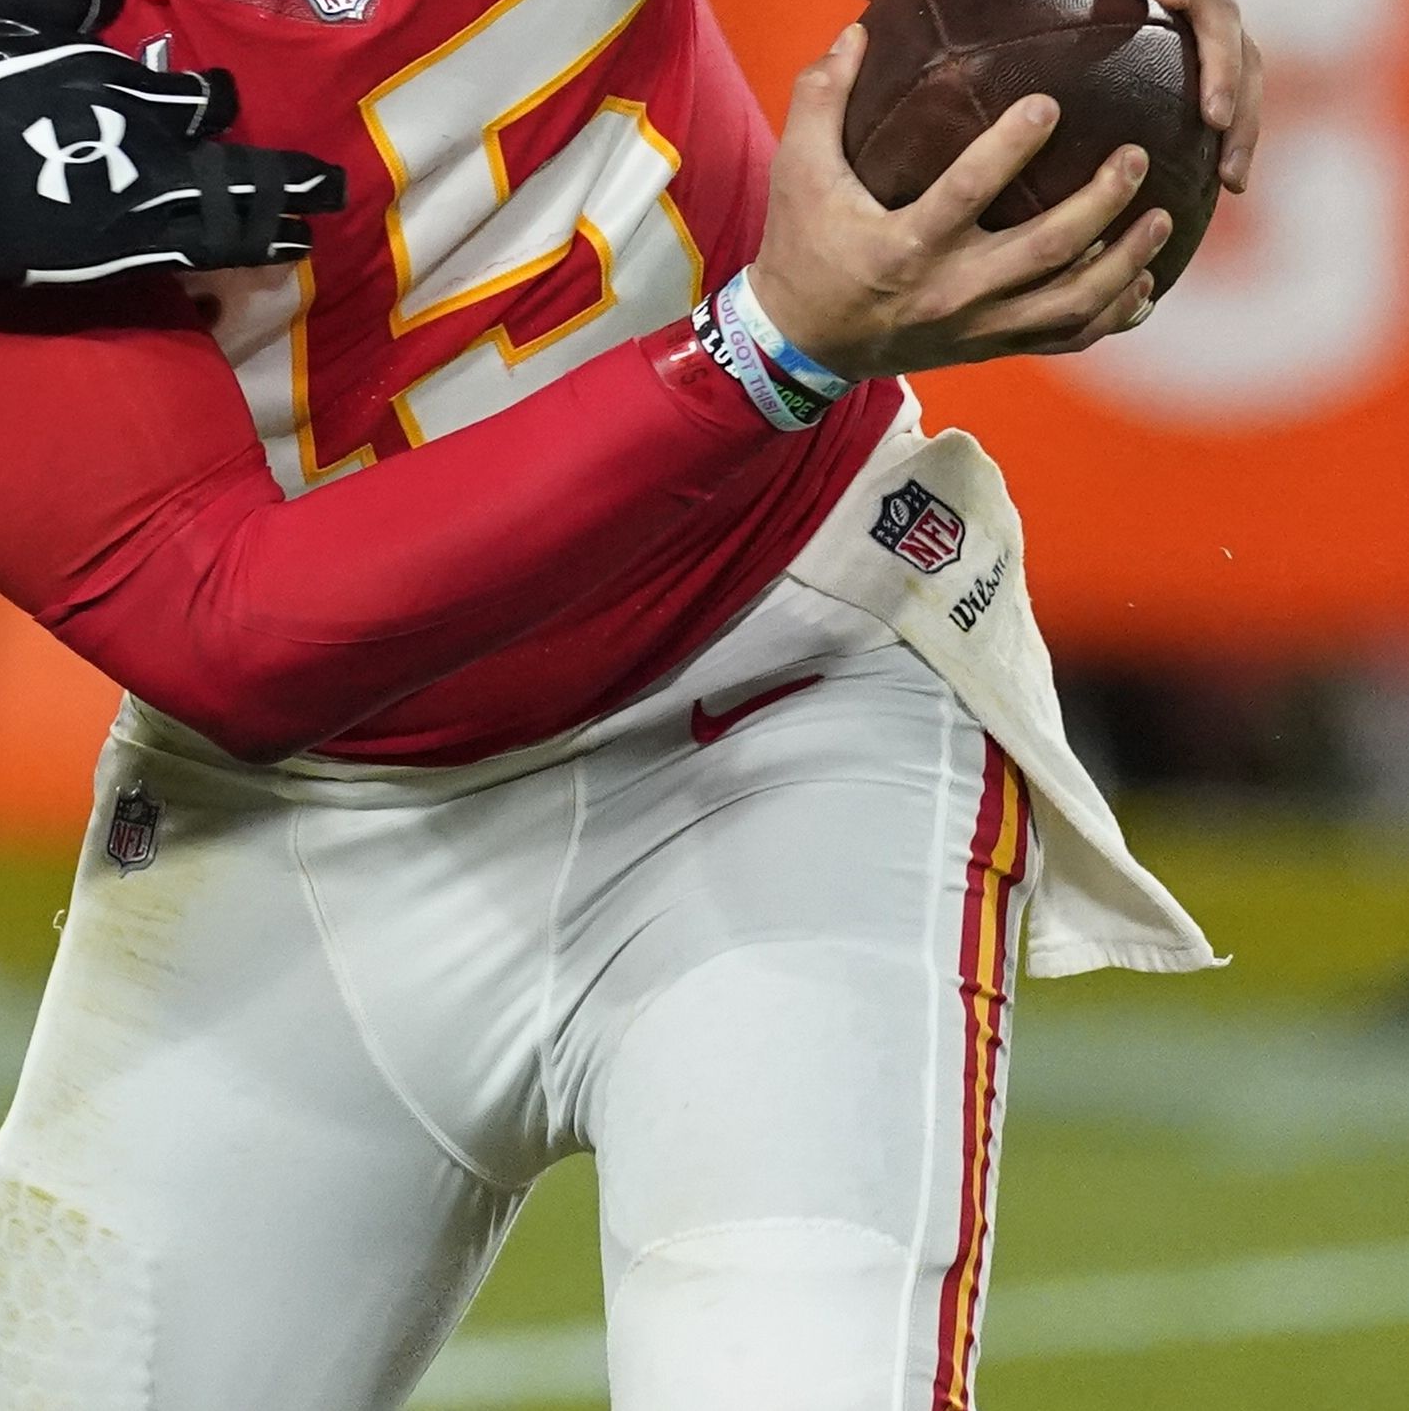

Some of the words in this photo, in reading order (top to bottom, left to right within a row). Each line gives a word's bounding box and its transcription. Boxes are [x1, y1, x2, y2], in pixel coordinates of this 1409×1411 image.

[730, 330, 758, 370] GOT
[749, 375, 781, 415] THIS!
[897, 507, 961, 570] NFL
[110, 820, 149, 859] NFL
